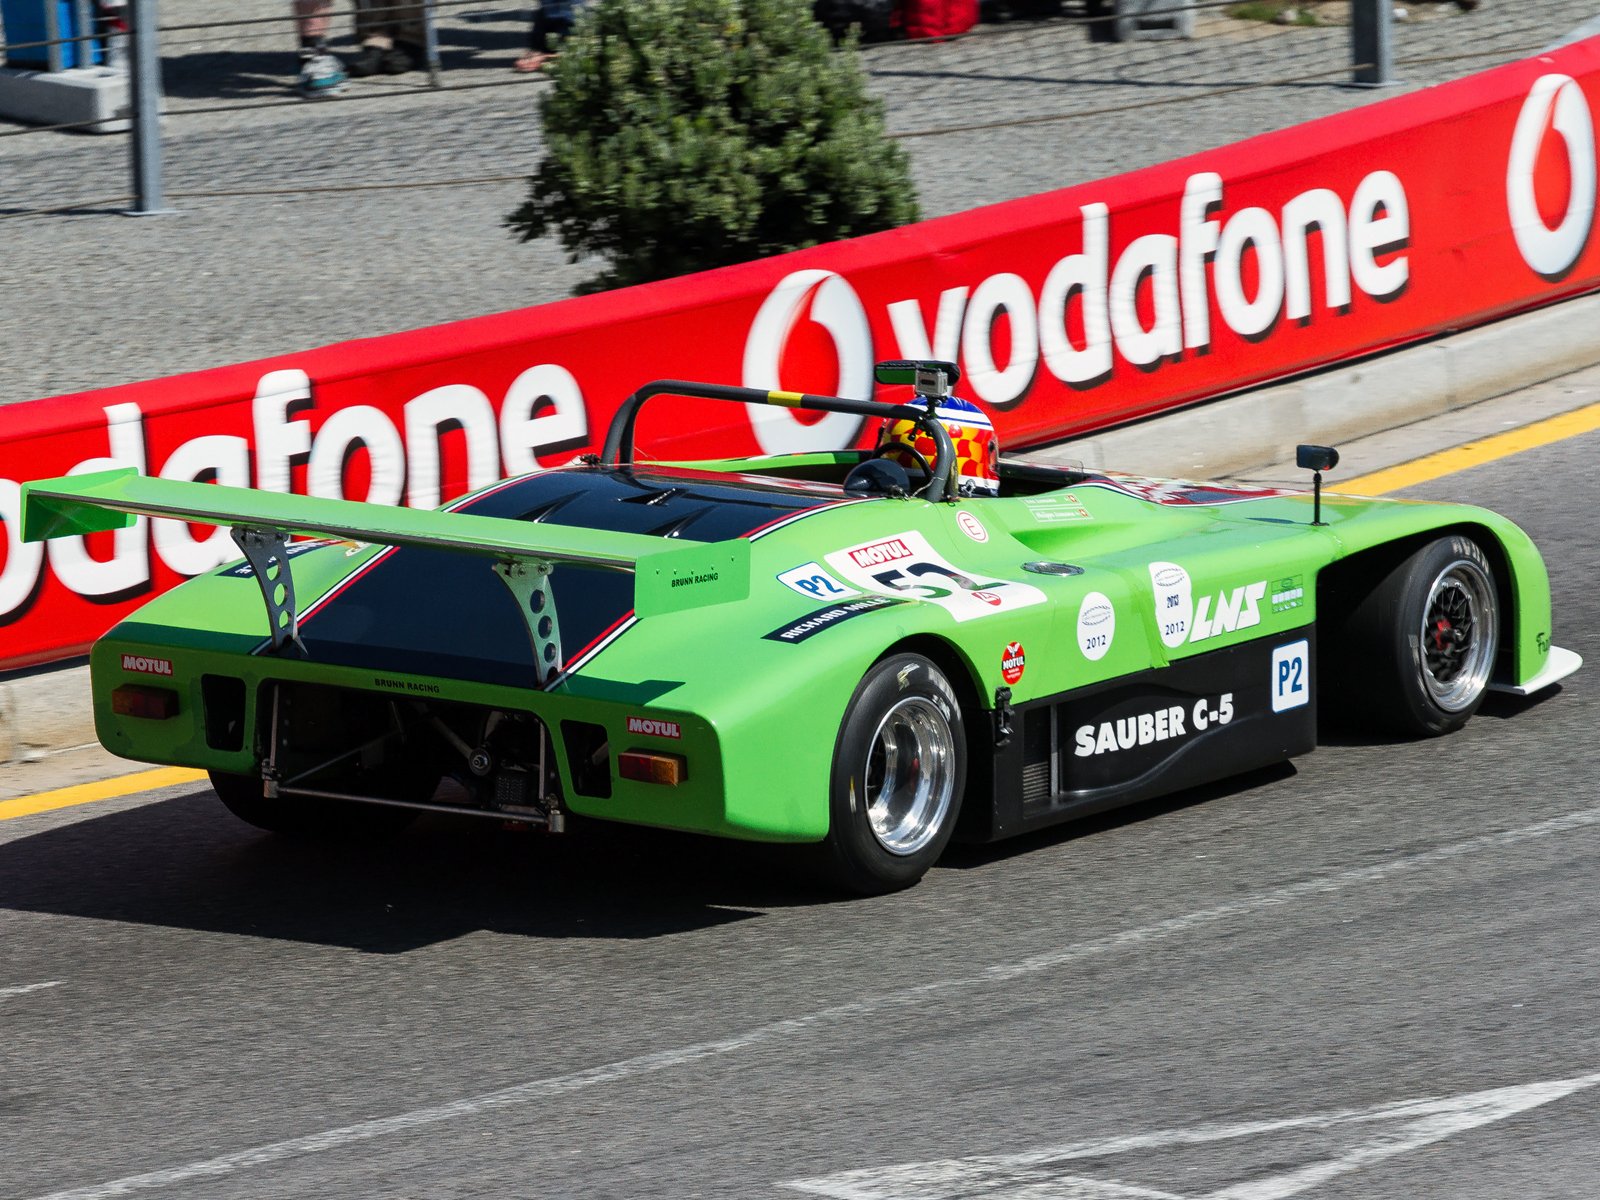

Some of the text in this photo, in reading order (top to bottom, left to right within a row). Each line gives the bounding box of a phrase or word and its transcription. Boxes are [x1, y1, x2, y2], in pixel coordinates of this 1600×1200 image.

[886, 170, 1409, 404] vodafone
[853, 539, 912, 567] MOTUL
[671, 572, 719, 588] BRUNN RACING
[795, 574, 845, 597] P2
[872, 562, 1010, 599] 52
[780, 597, 891, 639] RICHARD MILLE
[1189, 580, 1268, 643] LNS
[1165, 621, 1185, 635] 2012
[1086, 634, 1106, 650] 2012
[123, 655, 172, 675] MOTUL
[1002, 655, 1025, 670] MOTUL
[374, 678, 440, 694] BRUNN RACING
[1278, 656, 1303, 697] P2
[628, 717, 680, 738] MOTUL
[1074, 692, 1234, 758] SAUBER C-5
